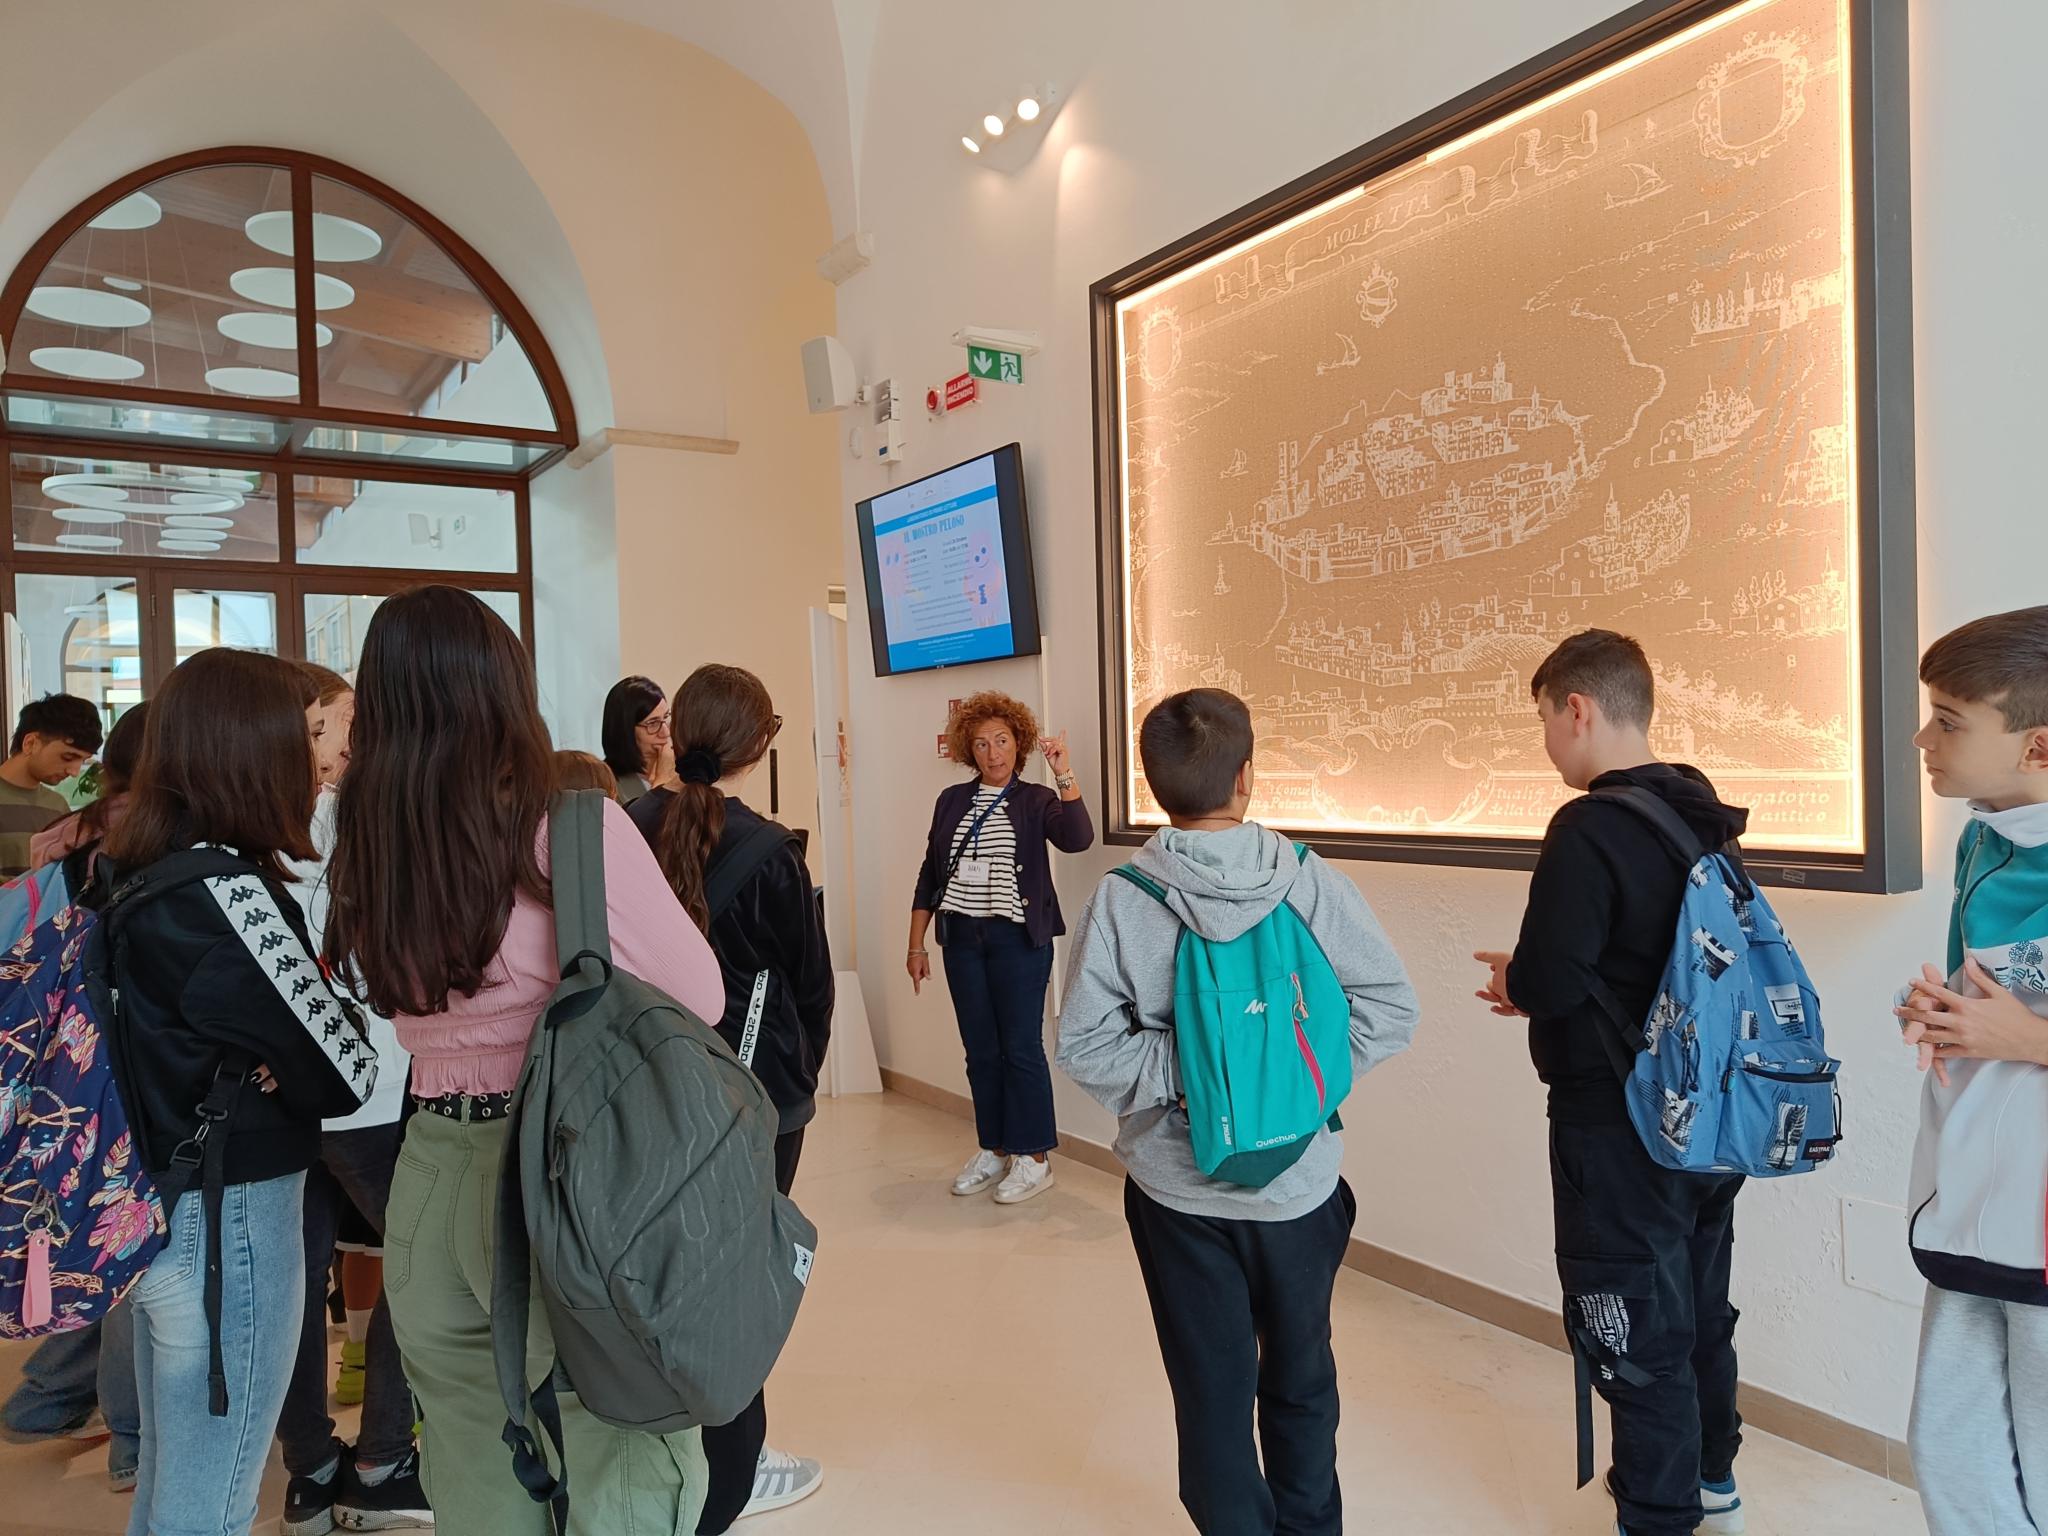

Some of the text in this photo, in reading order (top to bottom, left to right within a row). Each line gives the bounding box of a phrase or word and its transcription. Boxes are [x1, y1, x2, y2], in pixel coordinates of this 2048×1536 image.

[1320, 193, 1432, 254] MOLFETTA
[947, 386, 974, 405] INCENDIO
[912, 522, 938, 540] MOSTRO
[939, 514, 966, 533] PELOSO
[1255, 1132, 1297, 1148] Quechua
[1808, 1145, 1831, 1154] EASTPAK
